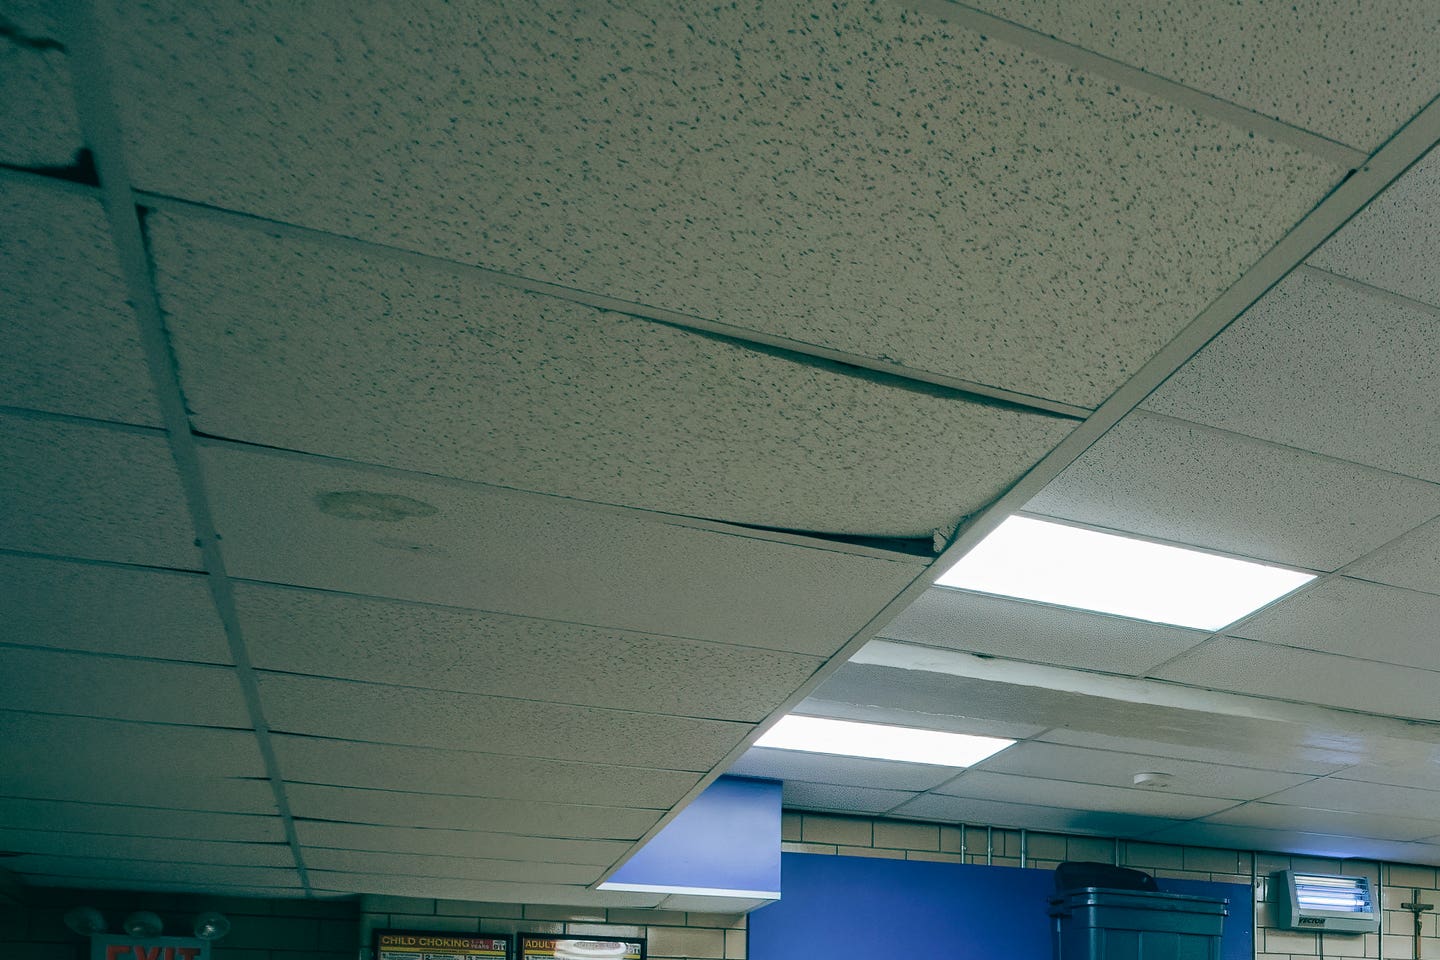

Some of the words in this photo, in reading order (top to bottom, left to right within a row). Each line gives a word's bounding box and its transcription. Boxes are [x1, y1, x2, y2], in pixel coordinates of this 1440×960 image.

[382, 935, 416, 946] CHILD
[419, 937, 470, 948] CHOKING
[525, 940, 556, 948] ADULT
